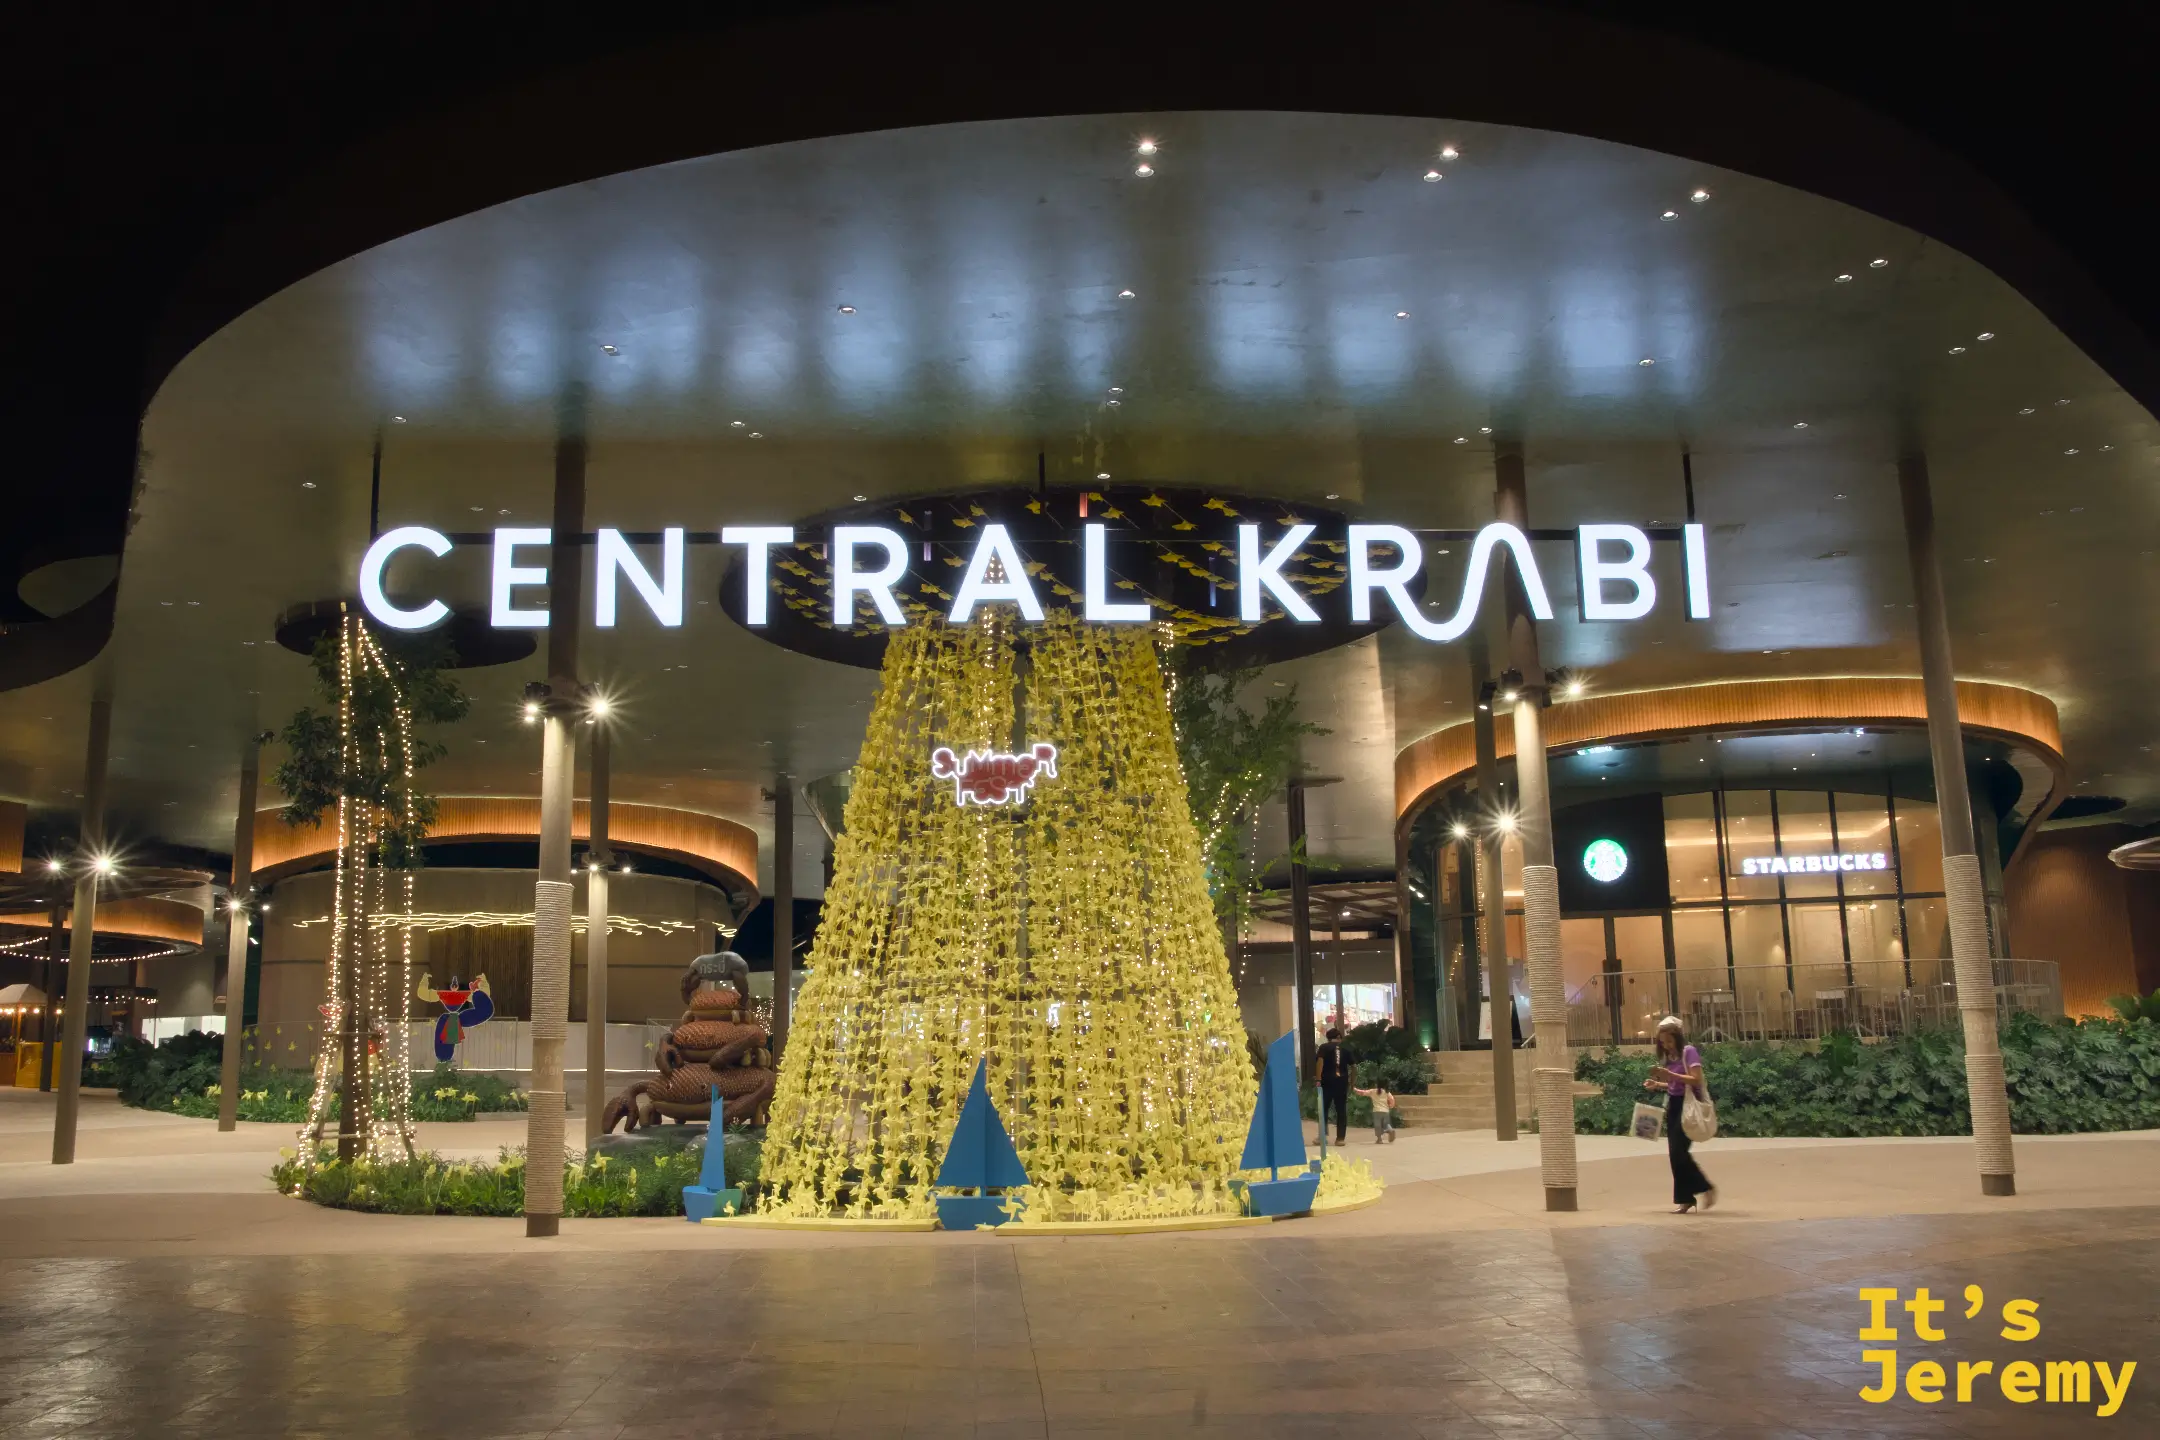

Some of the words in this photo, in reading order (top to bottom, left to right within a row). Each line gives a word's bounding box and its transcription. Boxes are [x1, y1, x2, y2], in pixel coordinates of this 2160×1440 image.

[359, 523, 1151, 629] CENTRAL
[1238, 522, 1710, 641] KRABI
[1741, 851, 1887, 875] STARBUCKS
